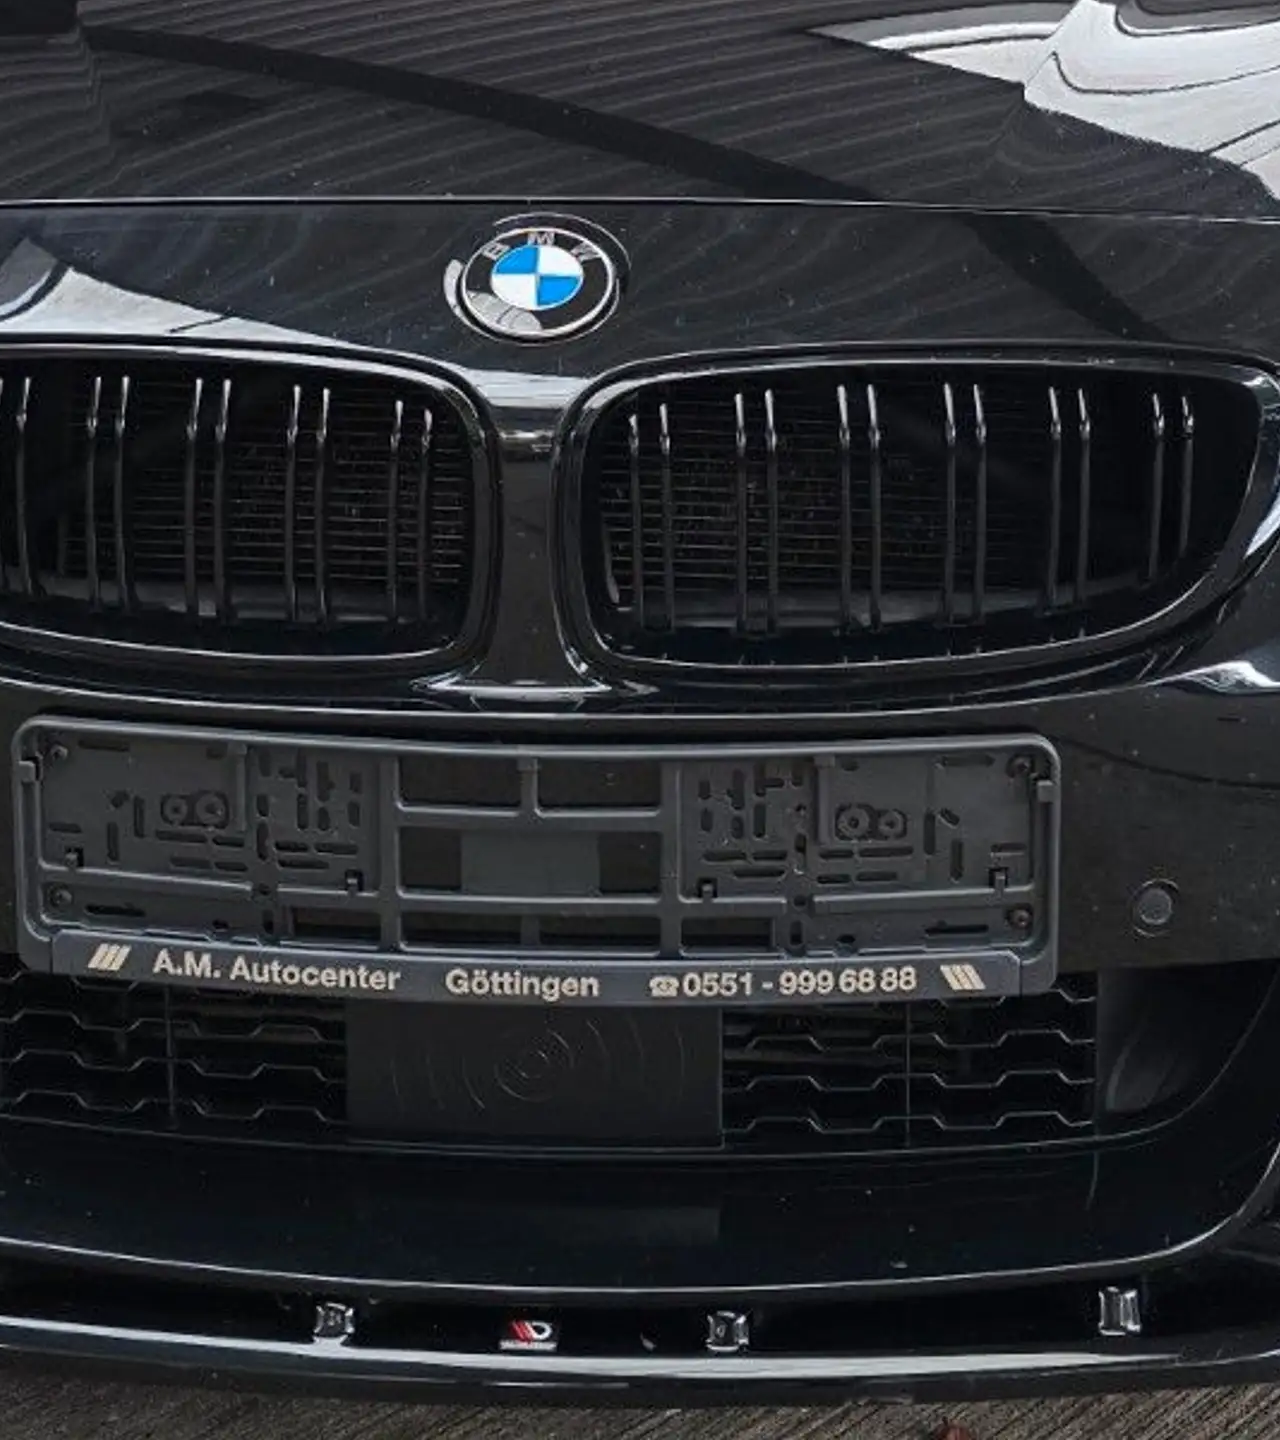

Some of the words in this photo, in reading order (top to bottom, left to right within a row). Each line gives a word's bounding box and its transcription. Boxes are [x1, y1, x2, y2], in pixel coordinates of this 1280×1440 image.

[481, 230, 601, 261] BMW
[153, 948, 221, 978] A.M.
[230, 956, 402, 990] Autocenter
[445, 968, 600, 1002] Göttingen
